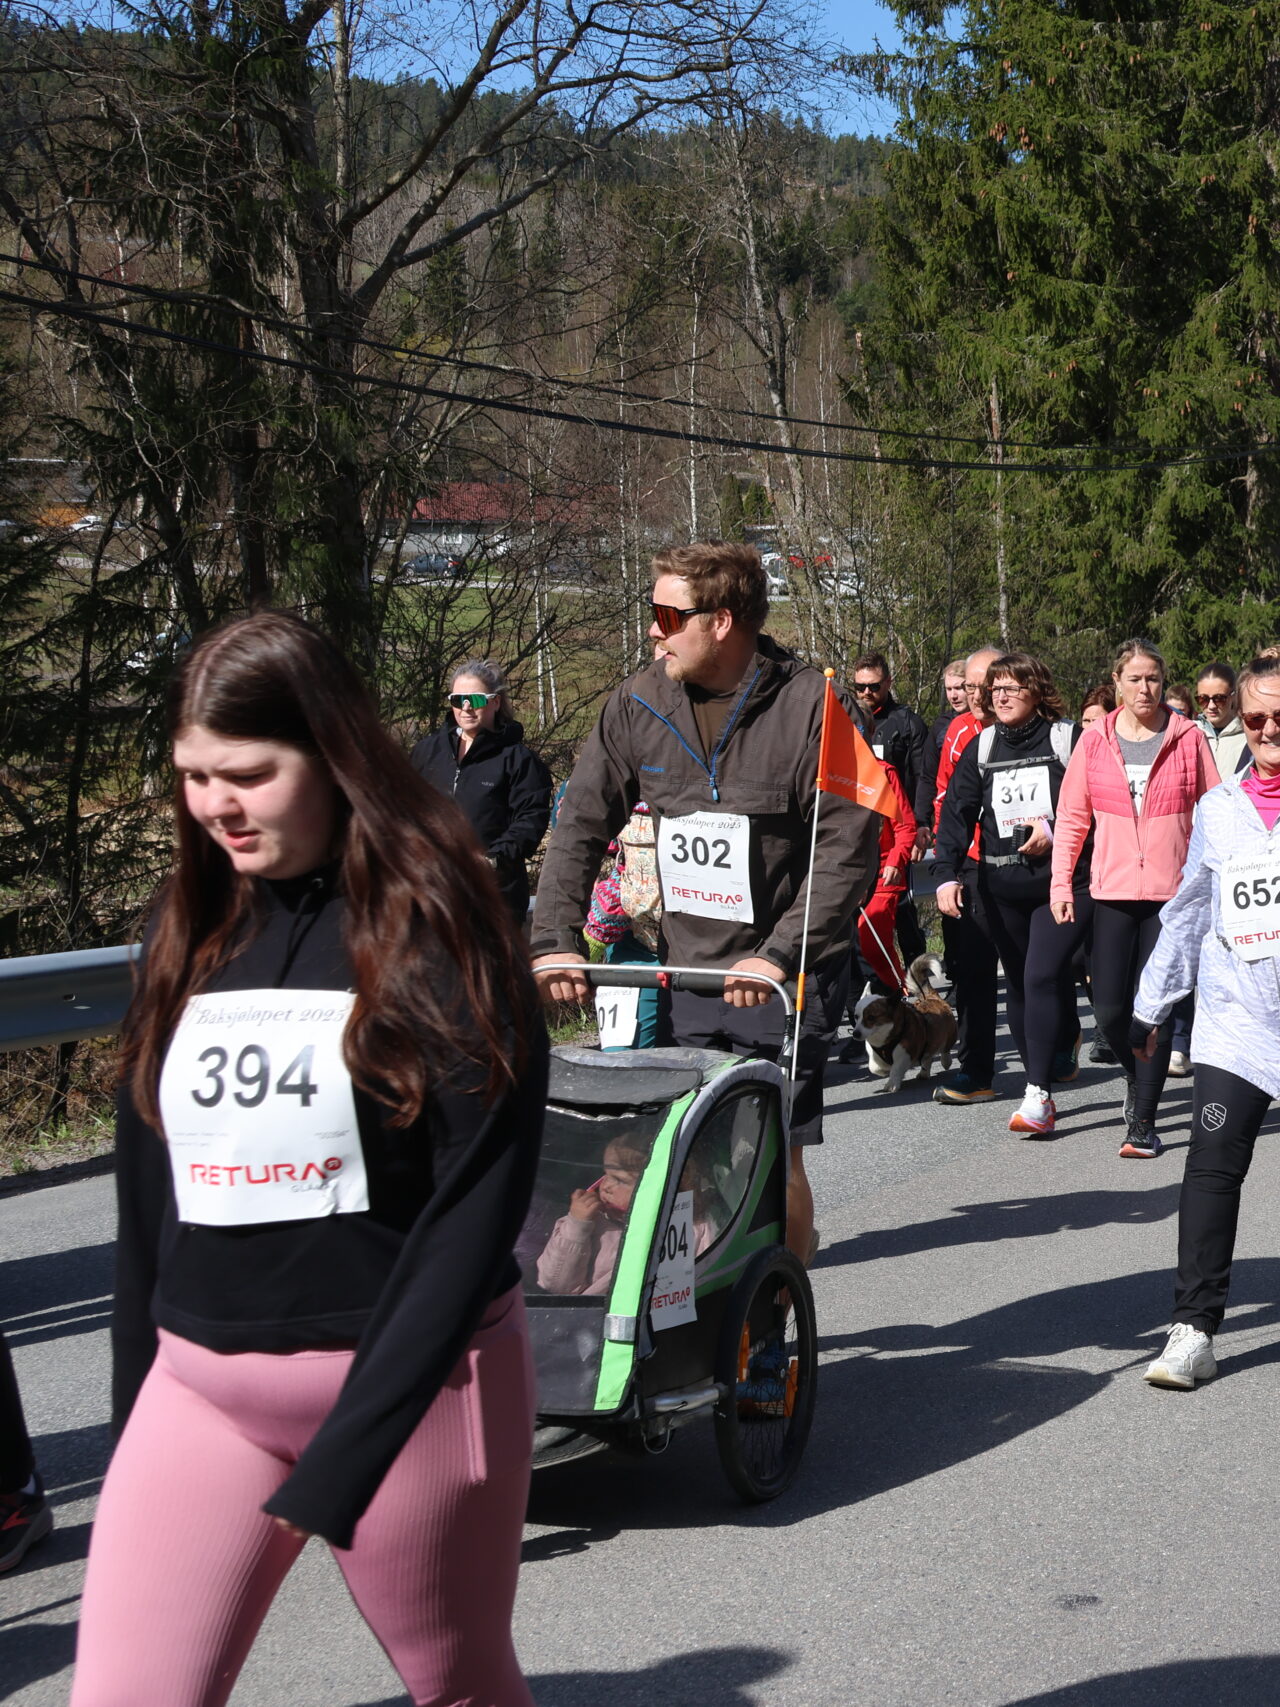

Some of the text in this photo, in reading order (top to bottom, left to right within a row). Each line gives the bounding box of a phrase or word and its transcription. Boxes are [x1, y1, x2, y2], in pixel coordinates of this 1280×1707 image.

[1001, 783, 1039, 804] 317
[671, 833, 732, 869] 302
[672, 886, 736, 905] RETURA
[299, 1007, 349, 1023] 2025
[598, 1003, 618, 1031] 01
[191, 1044, 319, 1108] 394
[189, 1162, 328, 1187] RETURA
[651, 1290, 687, 1309] RETURA
